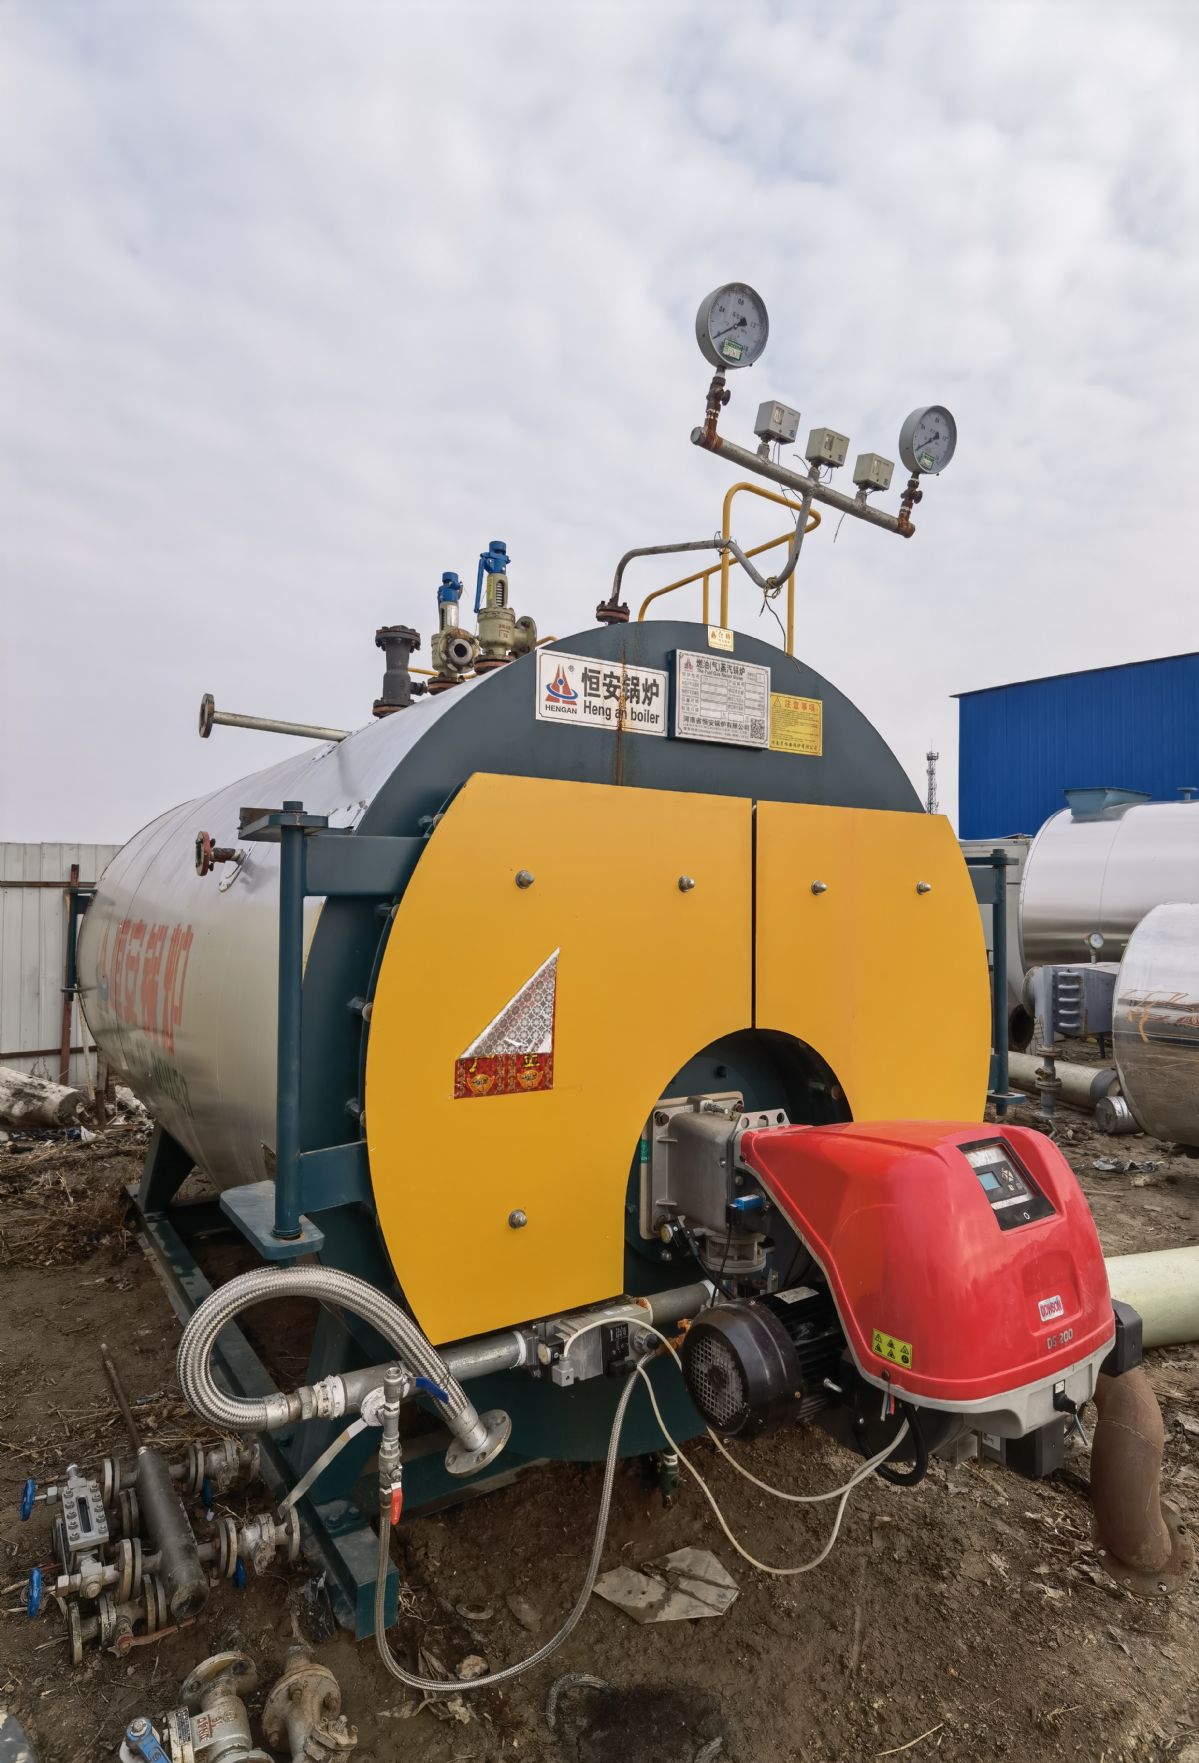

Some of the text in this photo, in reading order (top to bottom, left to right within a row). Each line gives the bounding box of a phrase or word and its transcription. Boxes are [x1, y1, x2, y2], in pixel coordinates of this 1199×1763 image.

[581, 667, 660, 706] 恒安锅炉
[545, 704, 577, 714] HENGAN
[583, 700, 611, 720] Heng
[630, 707, 660, 724] boiler
